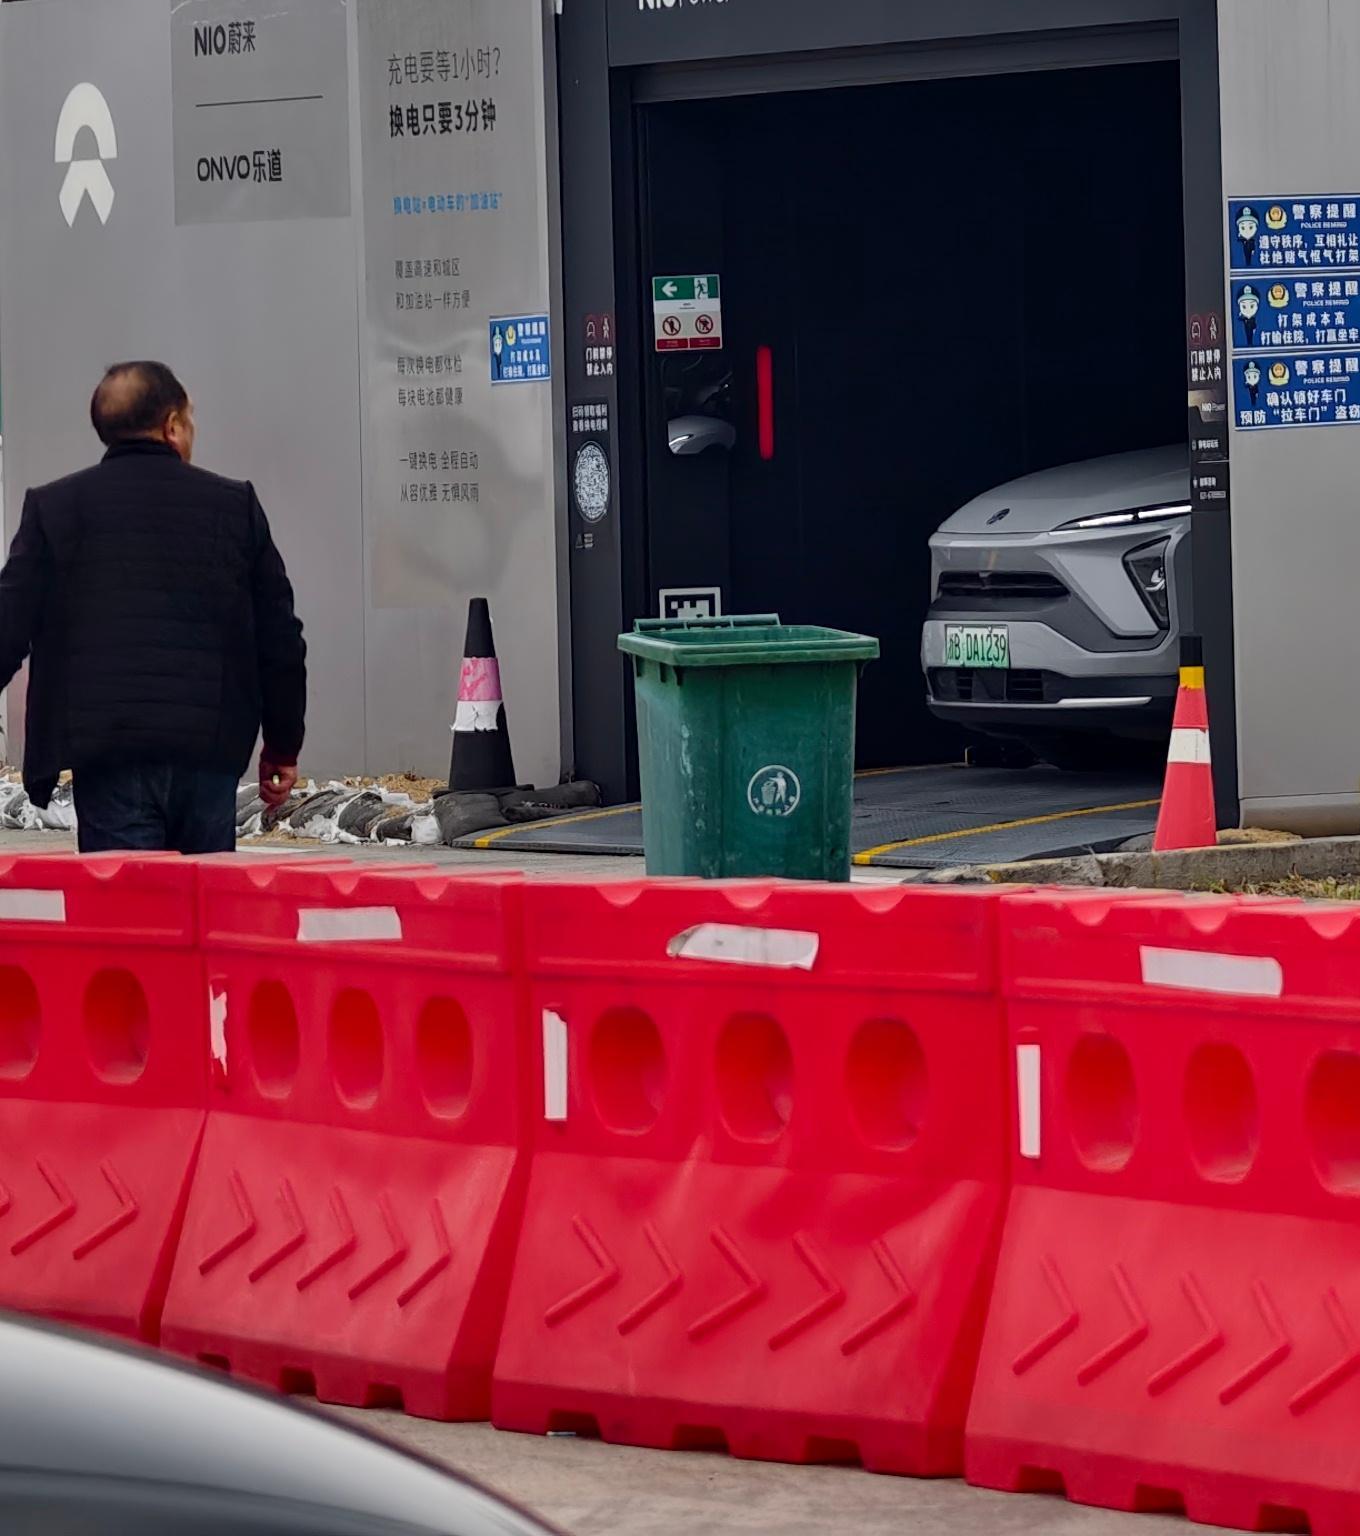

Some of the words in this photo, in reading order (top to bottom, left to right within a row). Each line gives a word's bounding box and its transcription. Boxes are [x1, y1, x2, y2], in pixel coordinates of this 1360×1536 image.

[389, 97, 497, 138] 换电只要3分钟
[1292, 203, 1357, 220] 警察提醒
[1294, 281, 1359, 298] 警察提醒
[1277, 311, 1345, 328] 打架成本高
[1295, 357, 1360, 376] 警察提醒
[1266, 389, 1346, 407] 确认锁好车门
